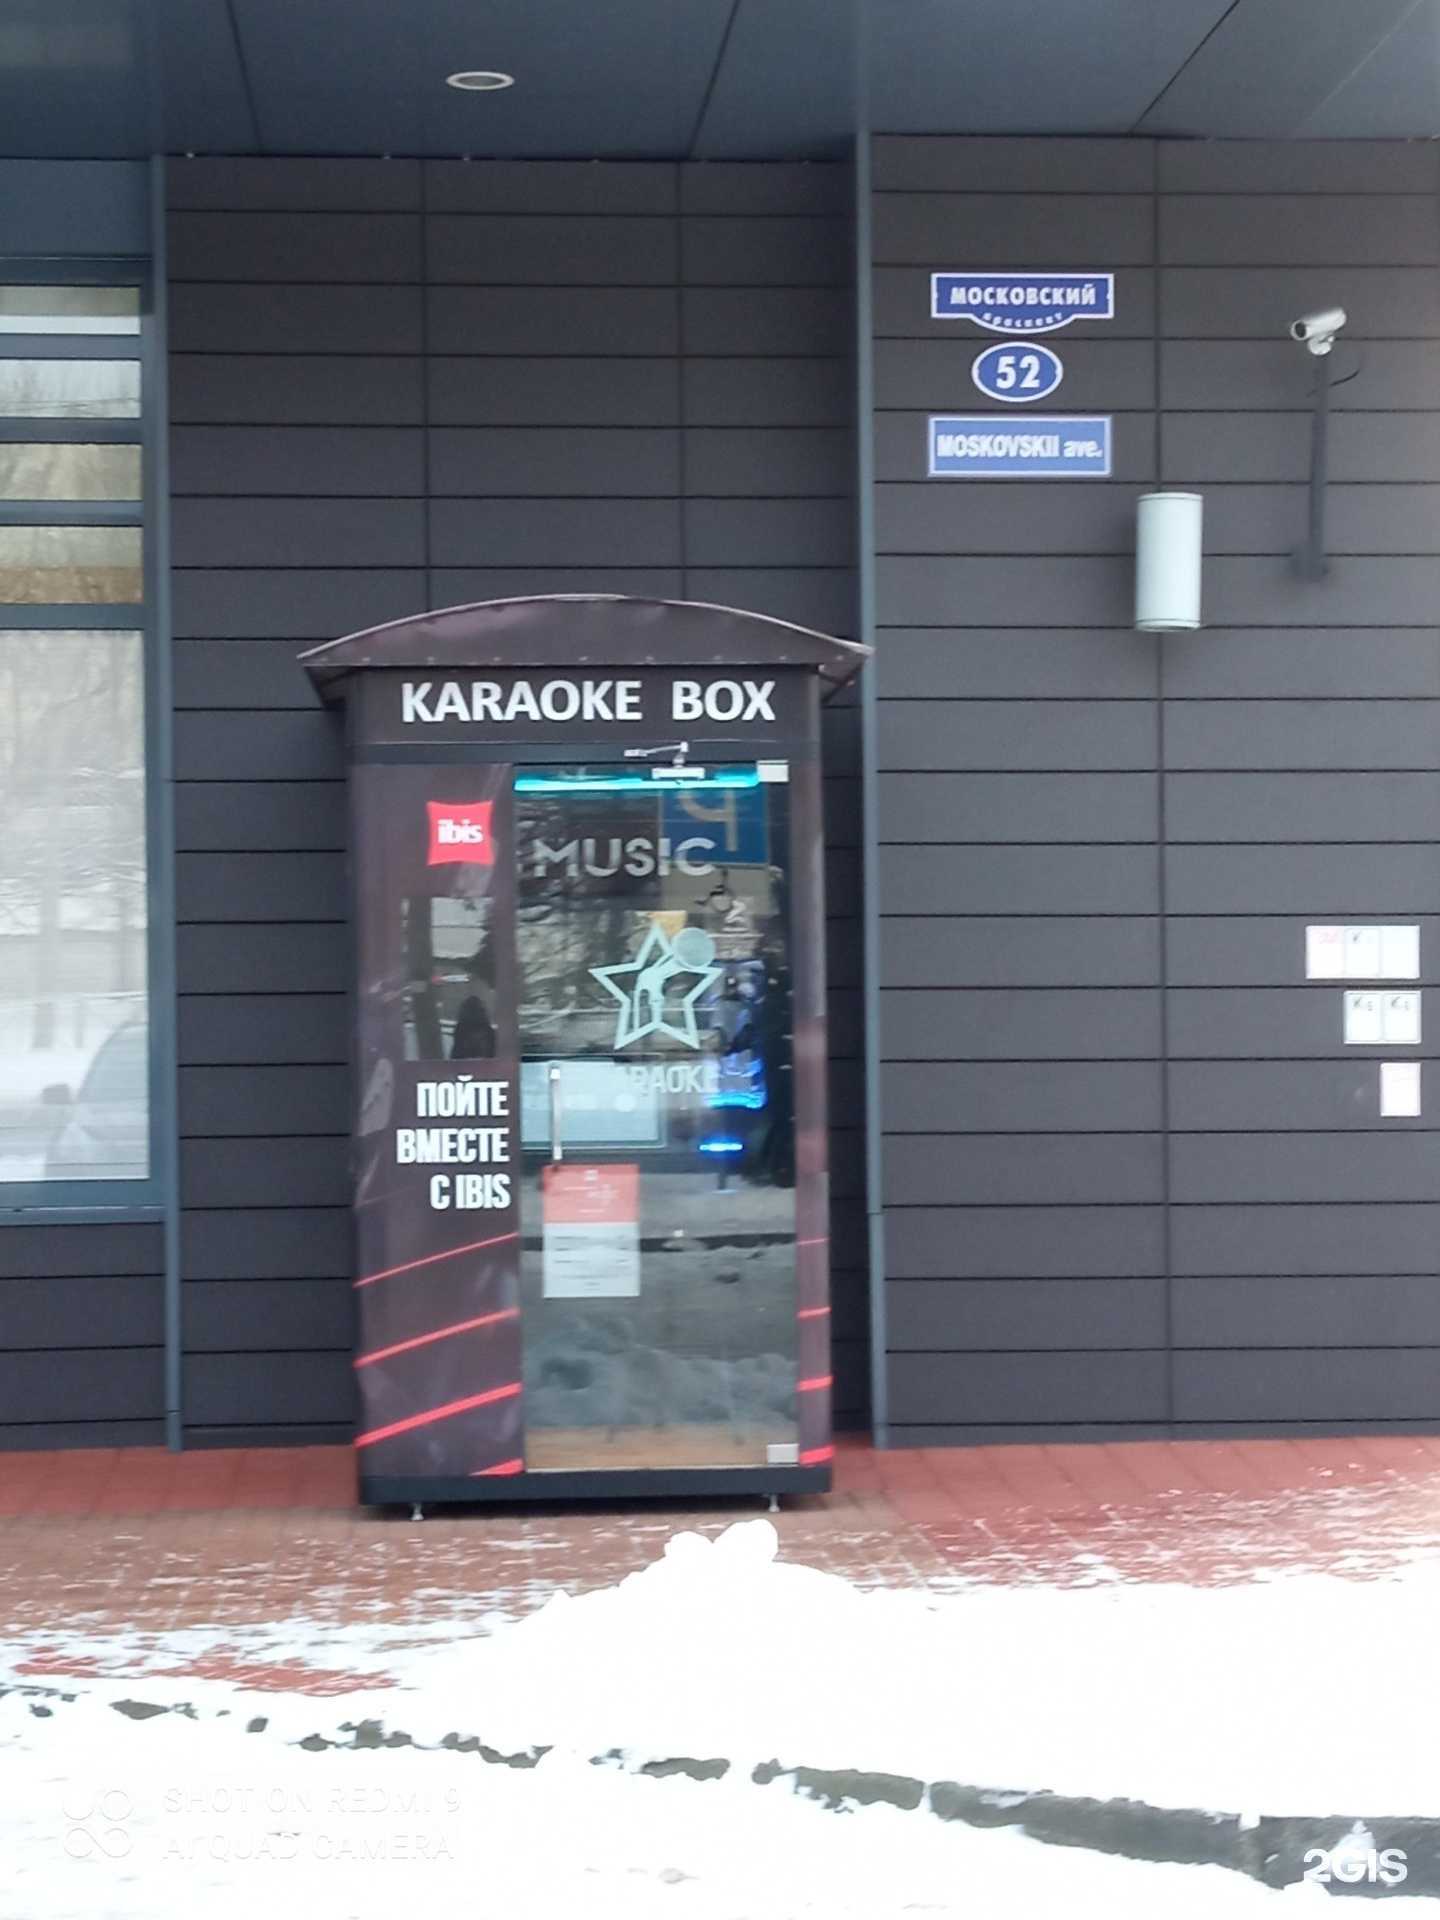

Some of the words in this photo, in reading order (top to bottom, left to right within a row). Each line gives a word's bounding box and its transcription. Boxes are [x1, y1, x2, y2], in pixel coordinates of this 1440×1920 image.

[950, 283, 1096, 305] МОСКОВСКИЙ
[996, 355, 1041, 389] 52
[936, 434, 1060, 457] MOSKOVSKII
[1063, 440, 1103, 457] ave.
[401, 680, 643, 723] KARAOKE
[672, 680, 776, 721] BOX
[437, 819, 483, 844] ibis
[532, 837, 716, 877] MUSIC
[417, 1075, 510, 1117] ПОЙТЕ
[396, 1128, 510, 1163] ВМЕСТЕ
[455, 1173, 511, 1209] IBIS
